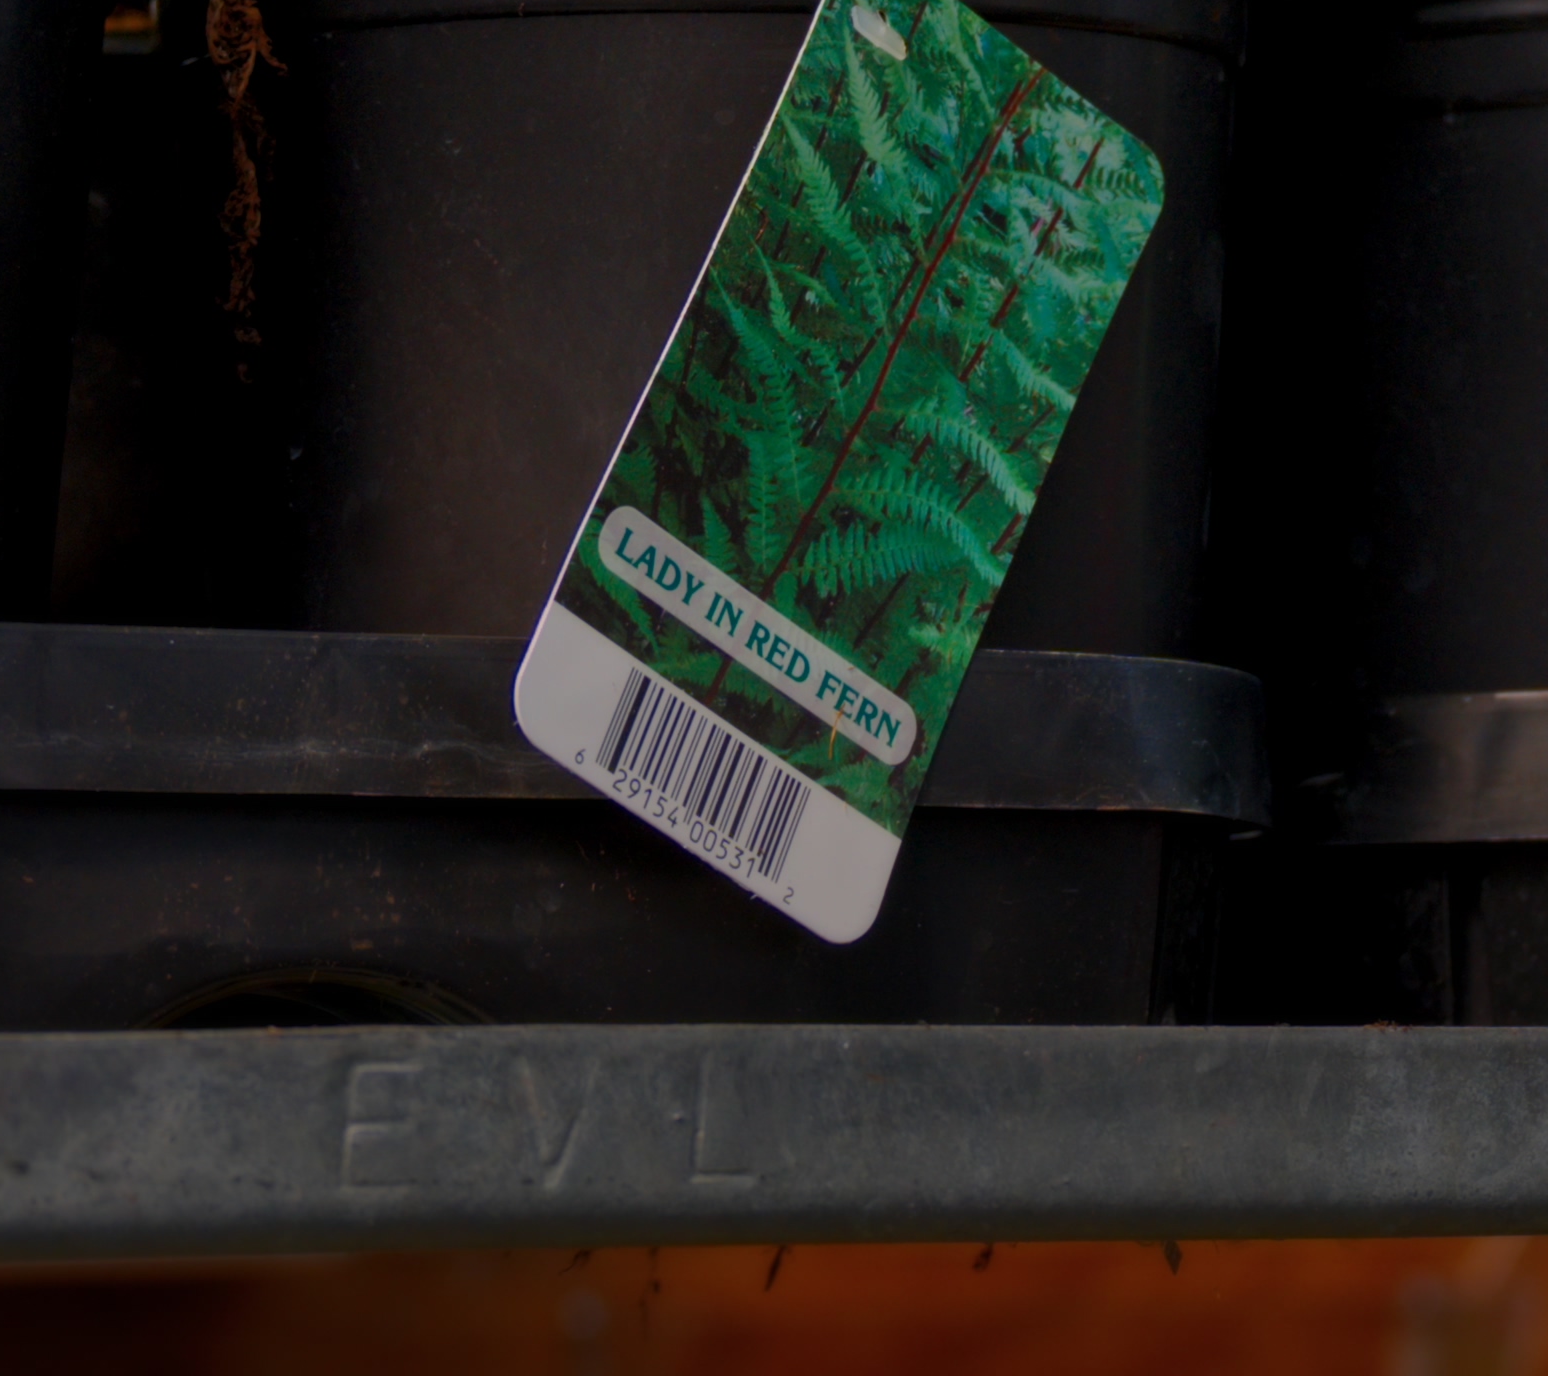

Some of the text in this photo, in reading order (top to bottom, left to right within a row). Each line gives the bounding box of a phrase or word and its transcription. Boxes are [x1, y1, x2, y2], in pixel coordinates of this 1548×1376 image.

[614, 527, 901, 748] LADY IN RED FERN
[574, 748, 795, 904] 6 29154 00531 2
